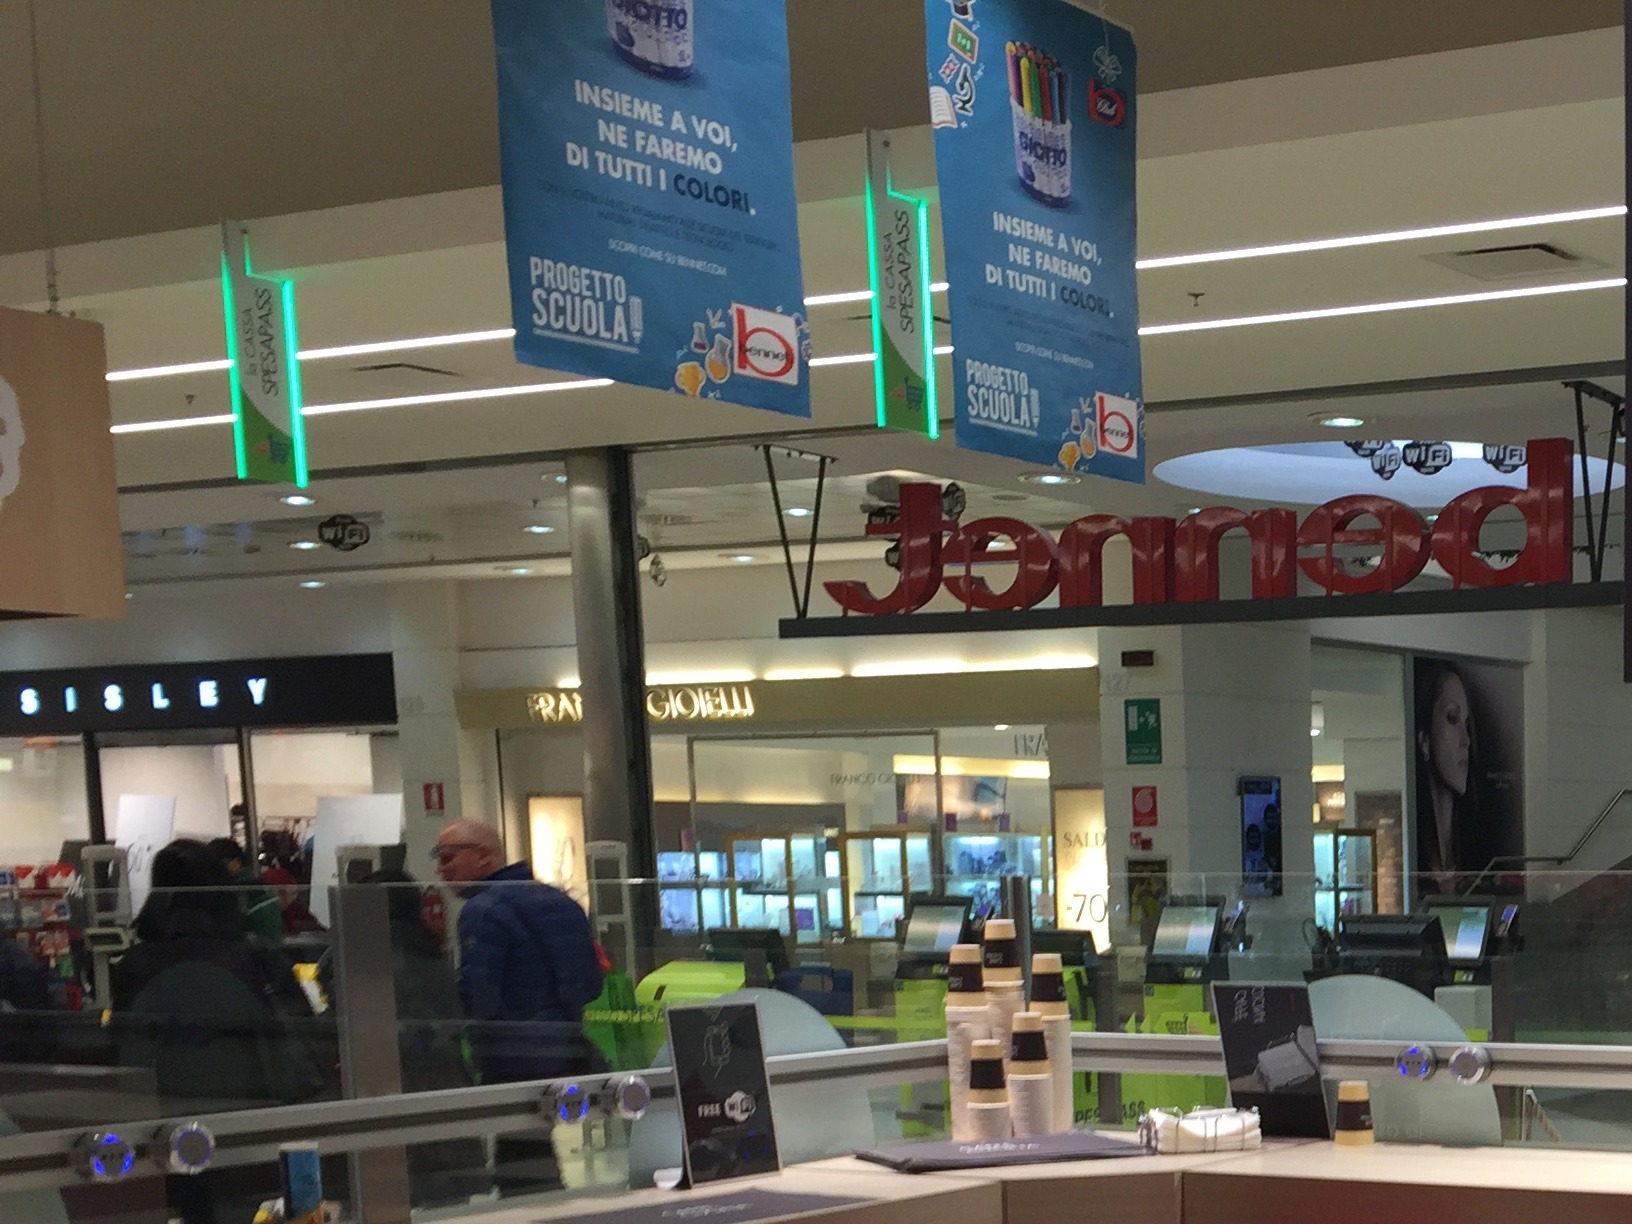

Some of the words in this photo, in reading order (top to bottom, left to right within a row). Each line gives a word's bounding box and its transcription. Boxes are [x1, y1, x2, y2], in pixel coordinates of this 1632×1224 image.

[573, 79, 664, 127] INSIEME
[670, 110, 687, 135] A
[691, 115, 738, 152] VOI,
[597, 118, 628, 149] NE
[634, 130, 722, 175] FAREMO
[1018, 131, 1067, 167] GIOTTO
[565, 142, 589, 170] DI
[594, 150, 652, 188] TUTTI
[658, 168, 667, 191] I
[673, 174, 756, 216] COLORI.
[993, 212, 1054, 248] INSIEME
[1057, 233, 1069, 253] A
[1071, 237, 1102, 266] VOI,
[529, 256, 627, 304] PROGETTO
[895, 209, 915, 334] SPESAPASS
[985, 263, 1003, 287] DI
[1006, 269, 1047, 298] TUTTI
[1050, 282, 1056, 300] I
[1008, 243, 1031, 267] NE
[1035, 251, 1092, 286] FAREMO
[255, 287, 279, 398] SPESAPASS
[966, 358, 1028, 397] PROGETTO
[19, 677, 268, 715] SISLEY
[526, 692, 583, 723] FRA
[646, 685, 755, 720] GIOIELLI
[698, 1102, 721, 1119] FREE
